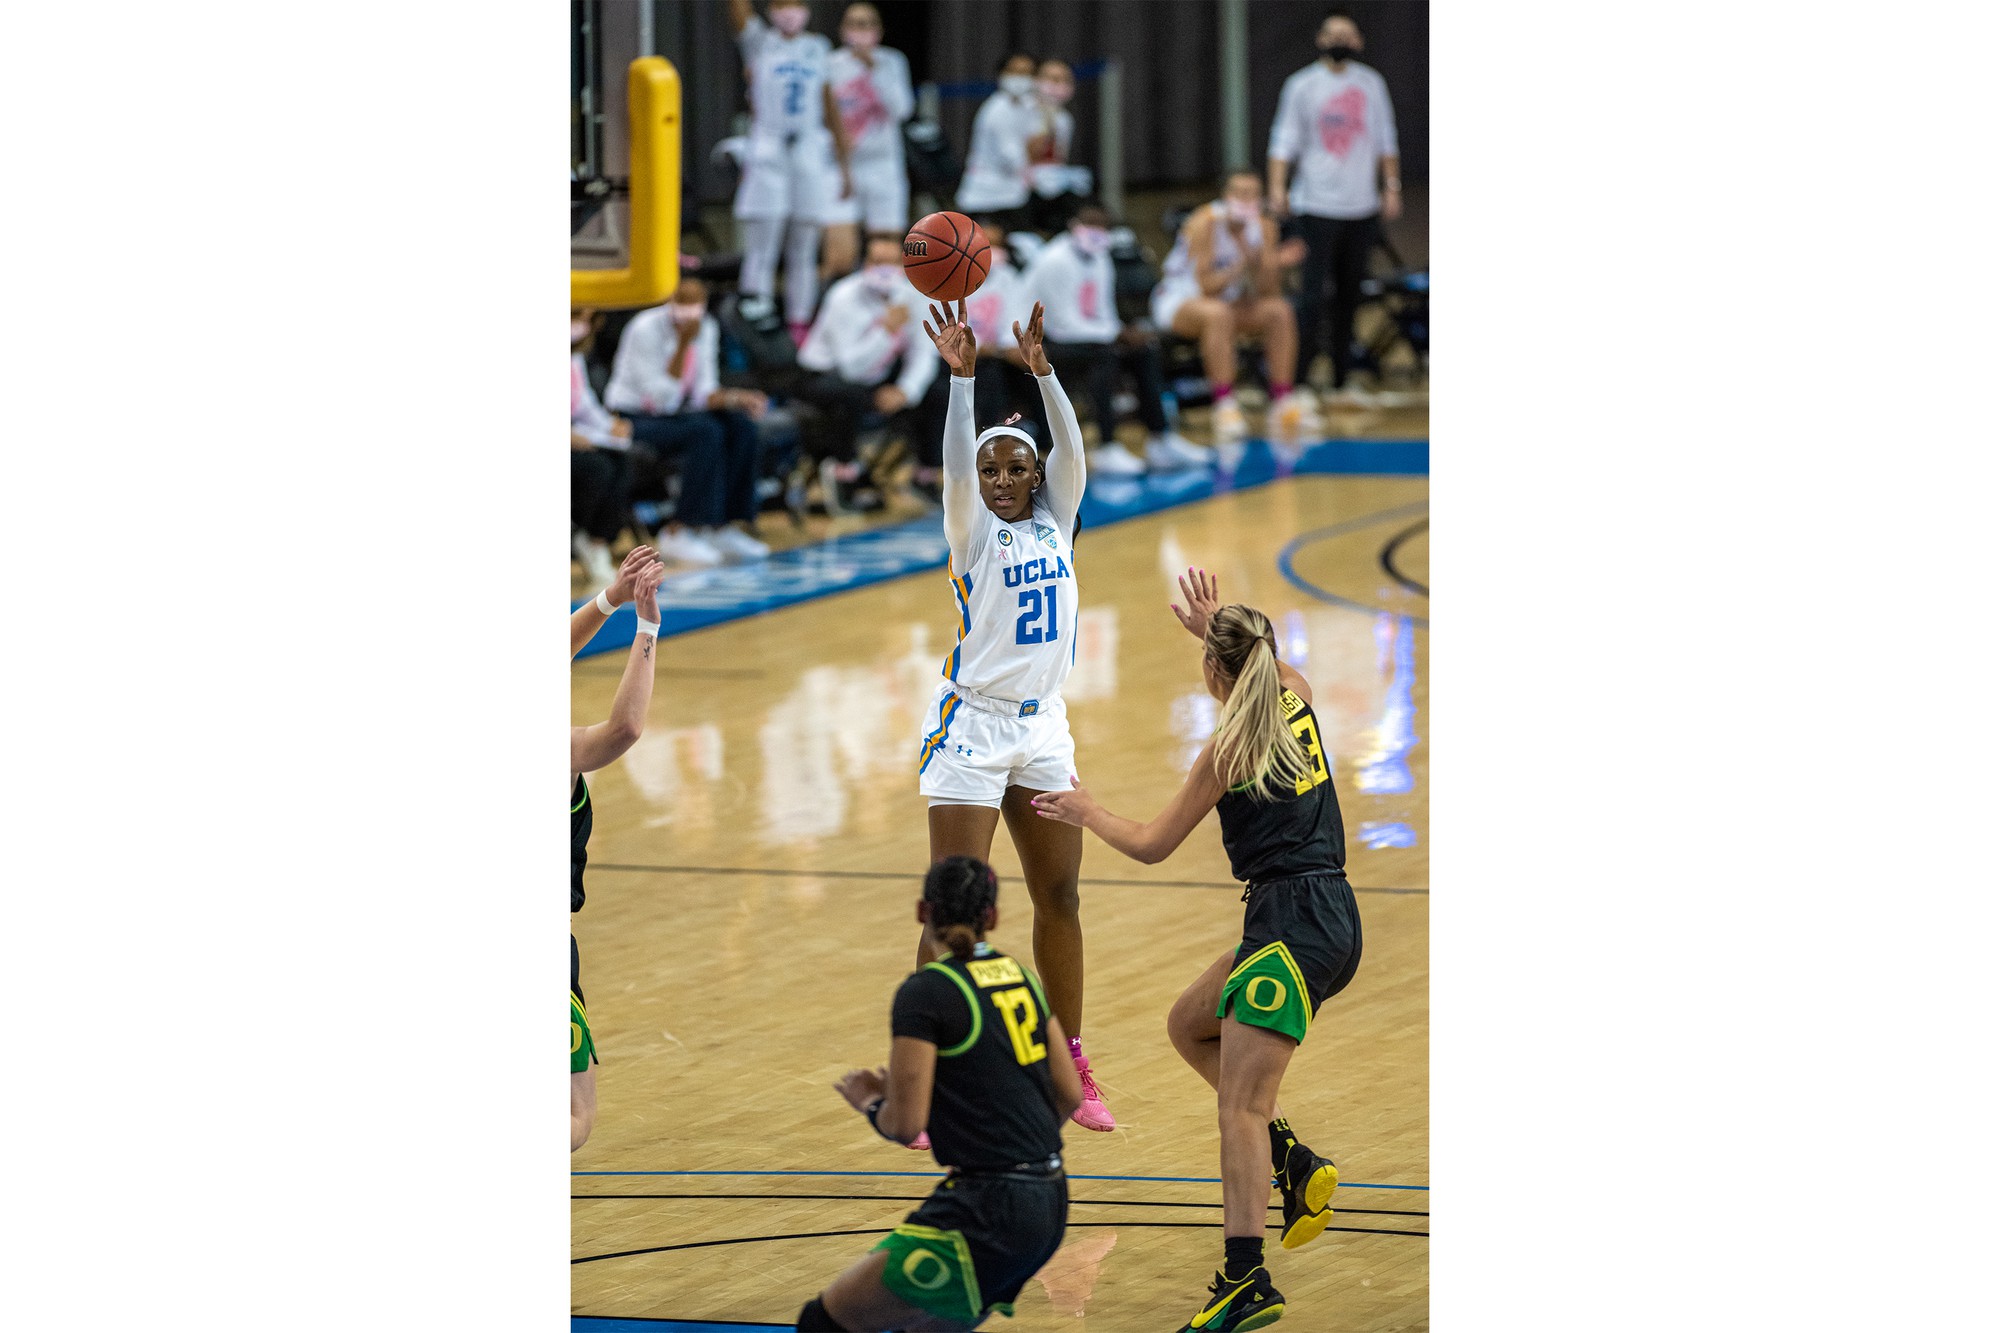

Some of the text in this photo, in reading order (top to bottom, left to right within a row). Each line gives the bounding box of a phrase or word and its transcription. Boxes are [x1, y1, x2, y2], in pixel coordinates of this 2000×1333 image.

[1003, 556, 1070, 588] UCLA
[1016, 585, 1059, 645] 21
[1246, 976, 1287, 1011] O
[990, 986, 1047, 1066] 12
[902, 1247, 951, 1290] O
